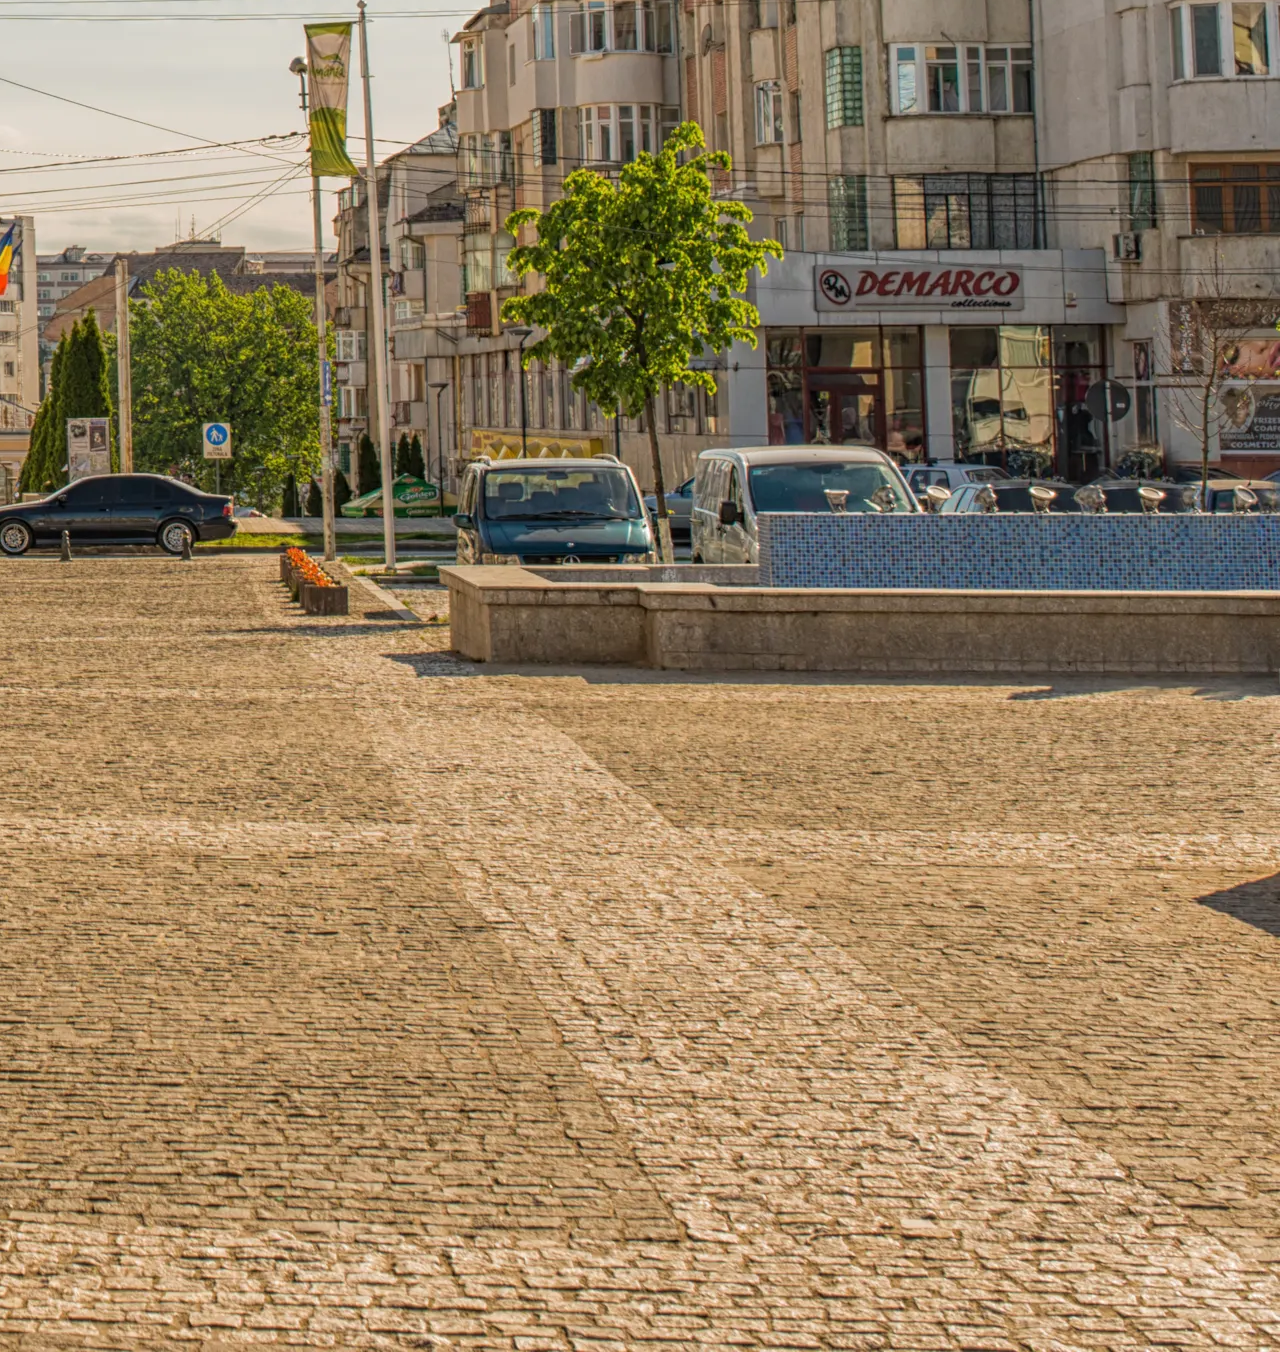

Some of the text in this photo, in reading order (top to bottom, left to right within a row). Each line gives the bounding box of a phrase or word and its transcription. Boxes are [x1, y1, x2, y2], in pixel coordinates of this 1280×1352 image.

[855, 269, 1020, 297] DEMARCO
[950, 299, 1012, 308] collections
[399, 490, 436, 502] Golden
